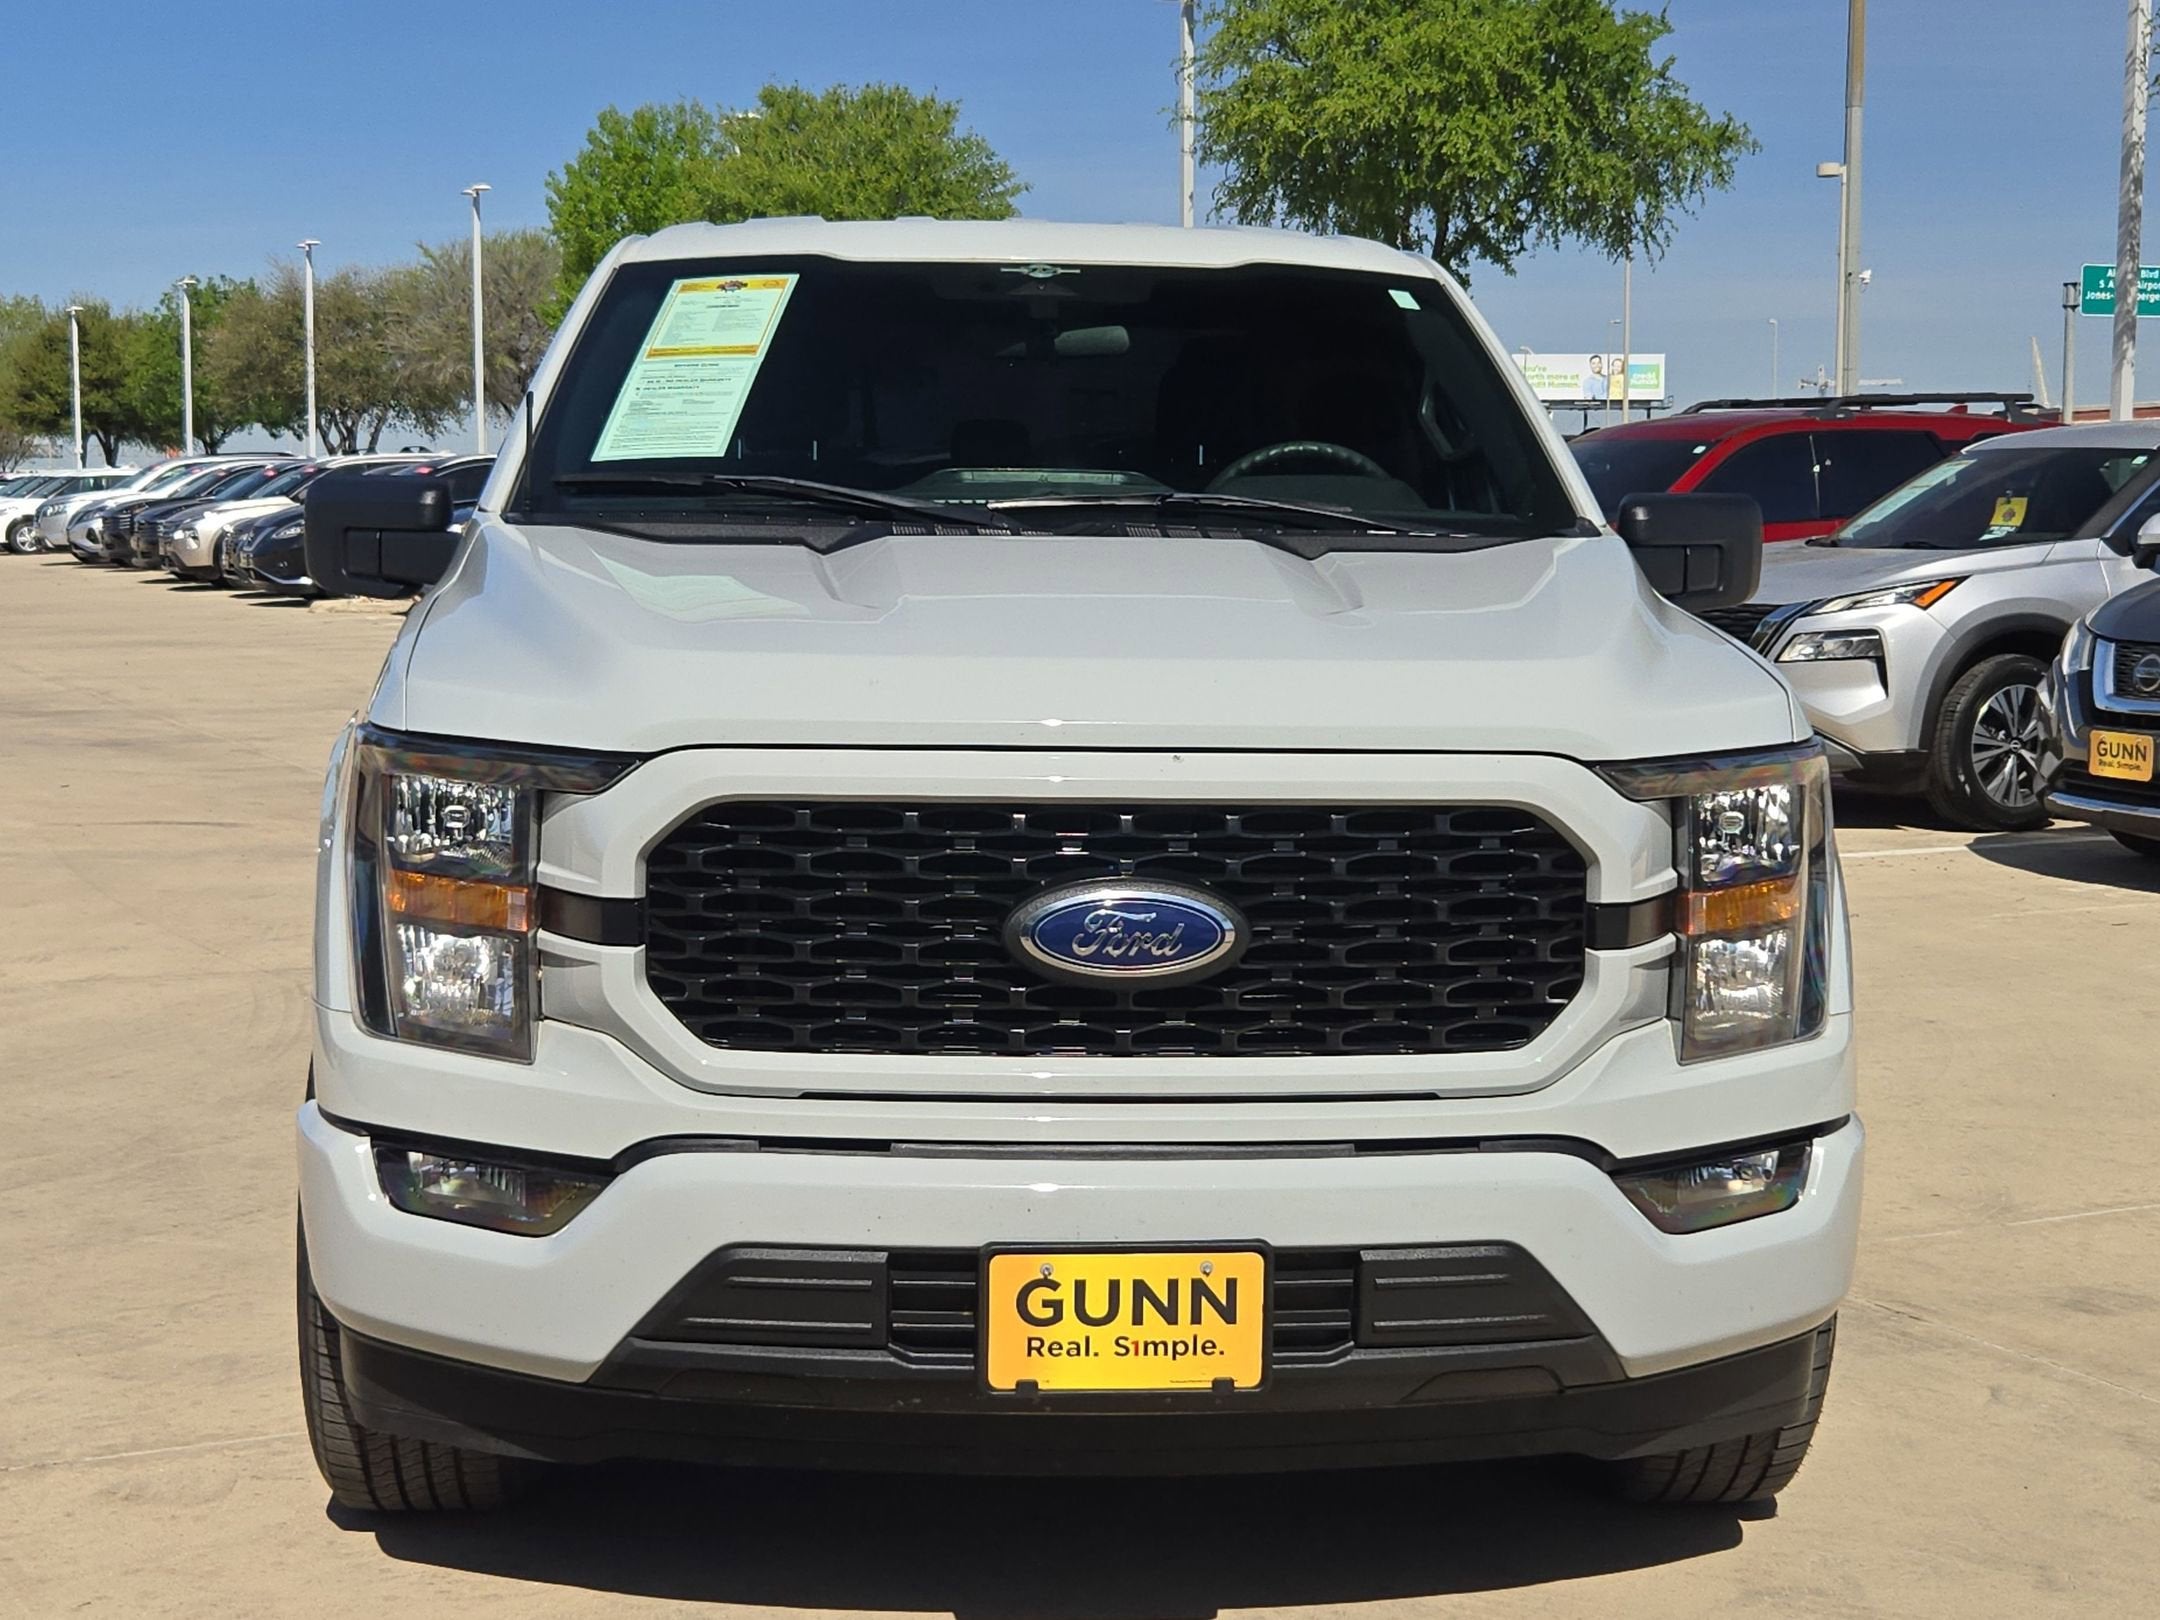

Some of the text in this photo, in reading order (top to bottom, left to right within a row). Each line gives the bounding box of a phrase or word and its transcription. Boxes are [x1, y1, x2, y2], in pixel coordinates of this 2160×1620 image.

[2098, 279, 2105, 288] S
[2140, 269, 2159, 278] Blvd
[2097, 740, 2147, 762] GUNN
[1072, 909, 1185, 958] Ford
[1016, 1277, 1238, 1327] GUNN
[1026, 1335, 1099, 1358] Real.
